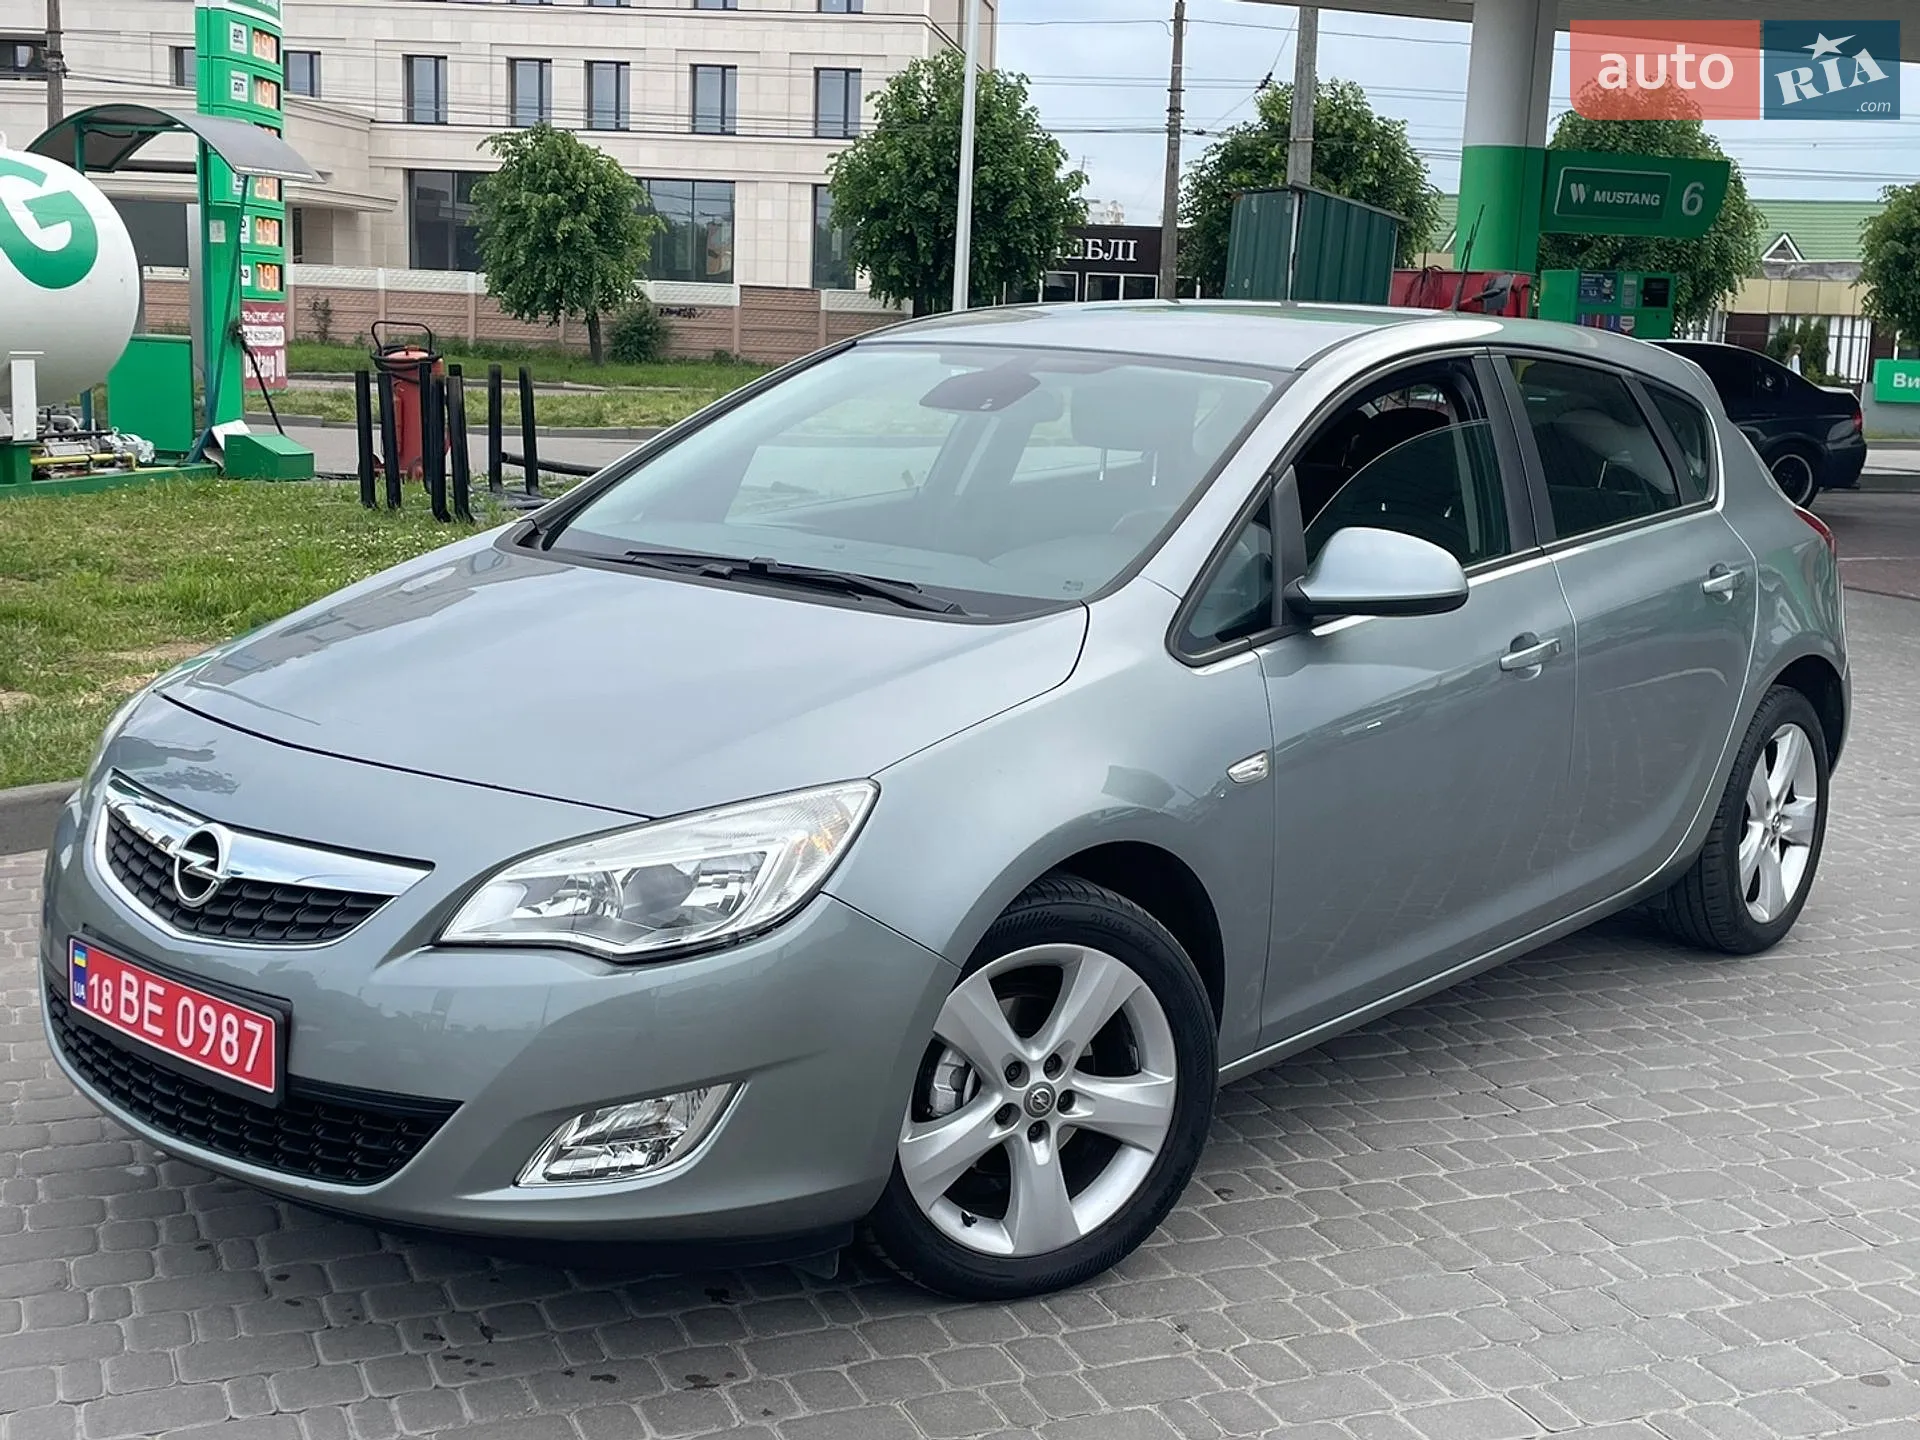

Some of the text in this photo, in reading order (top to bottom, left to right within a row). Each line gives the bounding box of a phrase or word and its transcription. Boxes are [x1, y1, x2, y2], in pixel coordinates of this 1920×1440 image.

[1593, 190, 1661, 206] MUSTANG
[1681, 181, 1705, 216] 6
[73, 980, 86, 1000] UA
[89, 970, 264, 1074] 18 BE 0987
